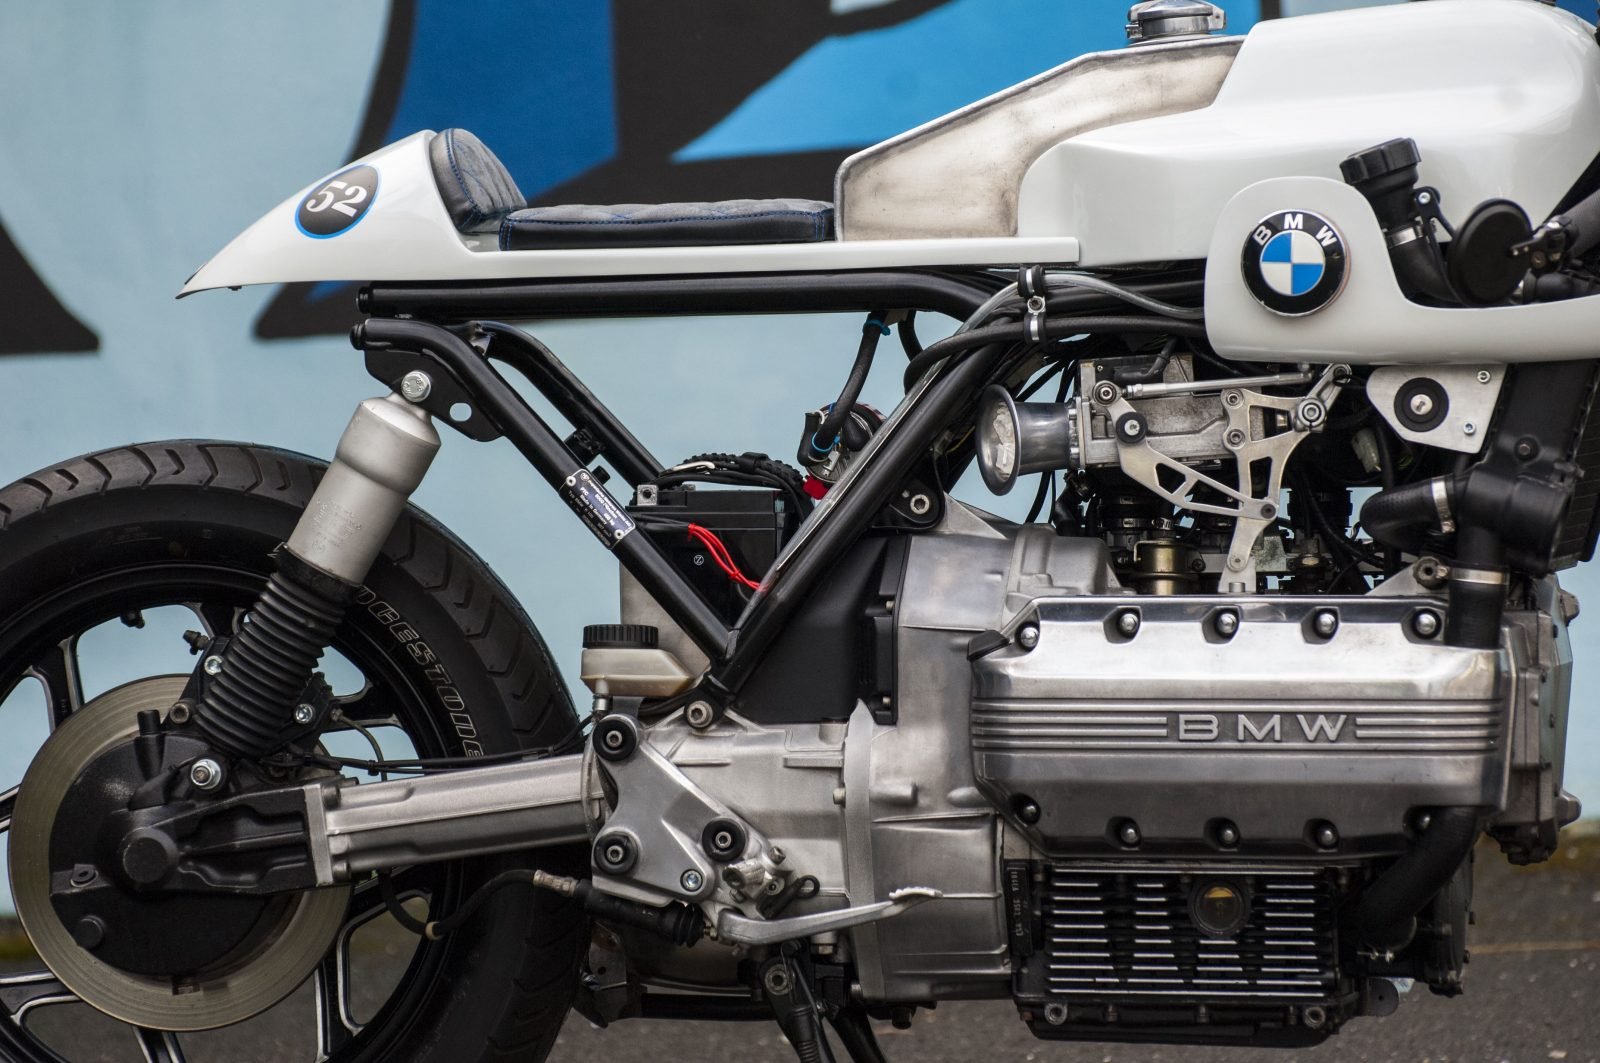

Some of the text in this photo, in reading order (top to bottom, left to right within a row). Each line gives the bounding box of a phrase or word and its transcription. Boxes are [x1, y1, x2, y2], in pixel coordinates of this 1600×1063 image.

[305, 180, 367, 218] 52
[1252, 213, 1337, 246] BMW
[1179, 714, 1347, 741] BMW
